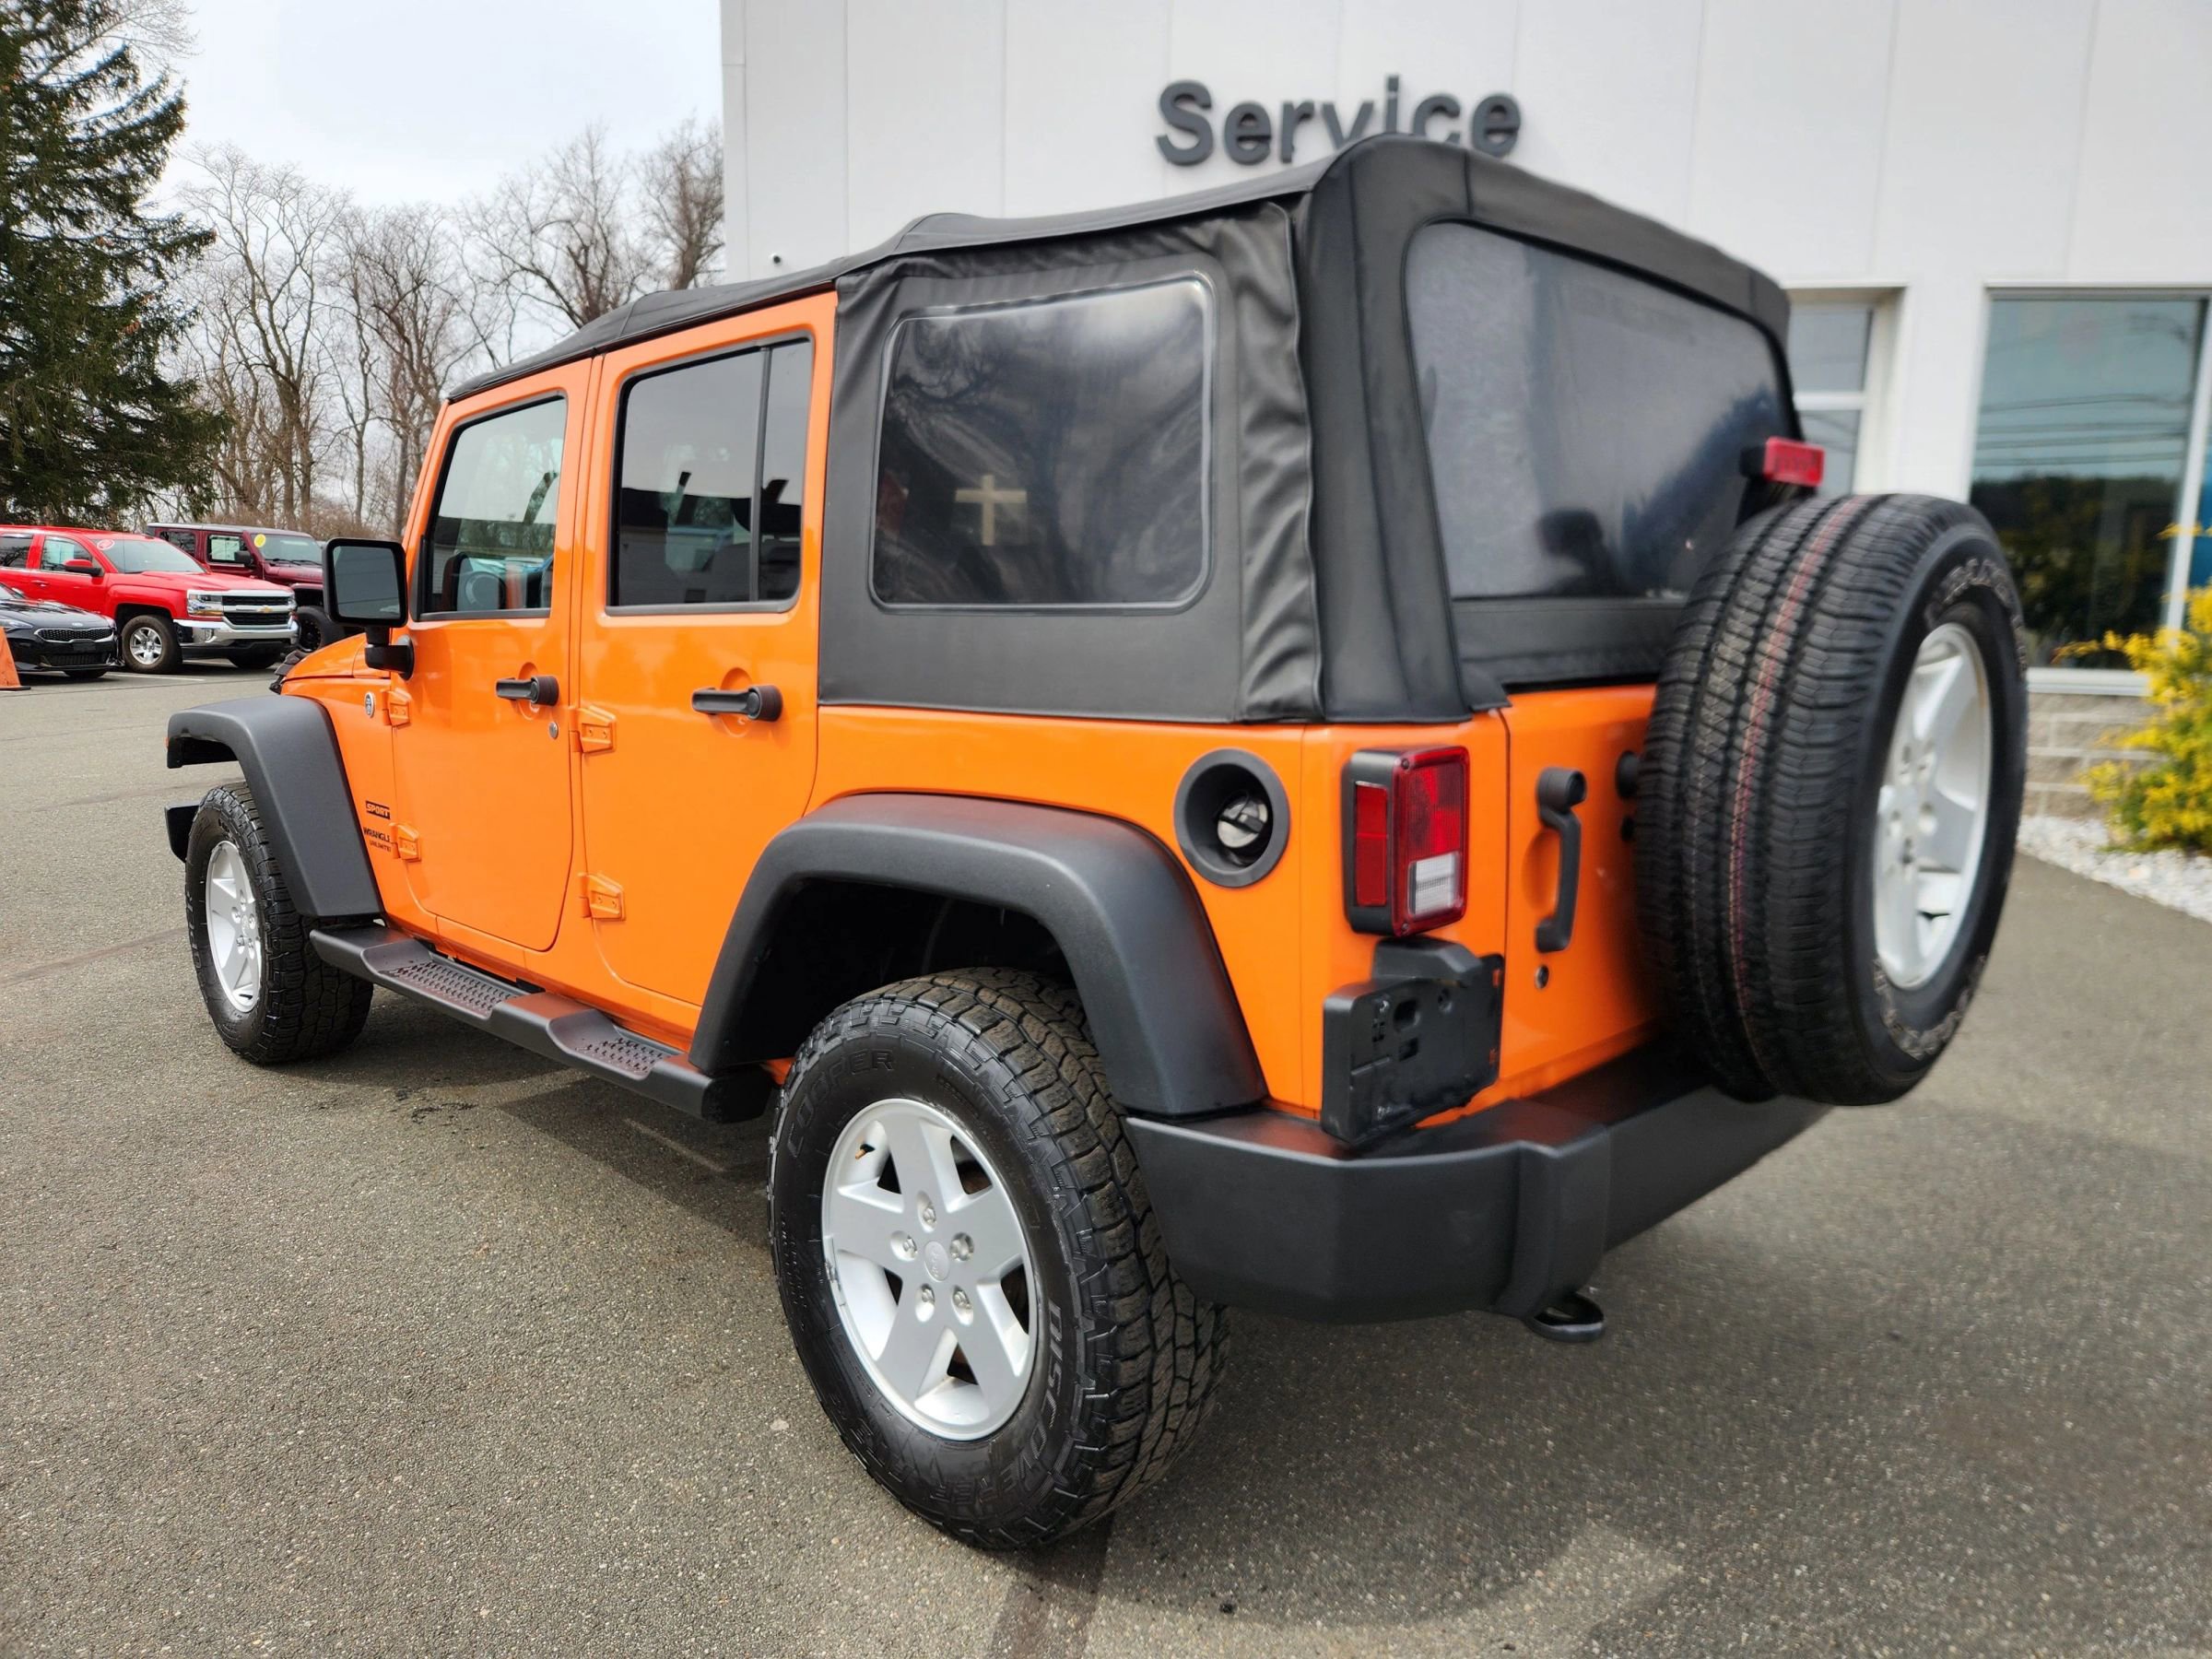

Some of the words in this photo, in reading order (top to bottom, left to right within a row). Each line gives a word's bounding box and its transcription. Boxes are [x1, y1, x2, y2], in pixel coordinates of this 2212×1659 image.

[1155, 75, 1522, 167] Service
[366, 802, 390, 818] SPORT
[787, 1048, 894, 1159] COOPER
